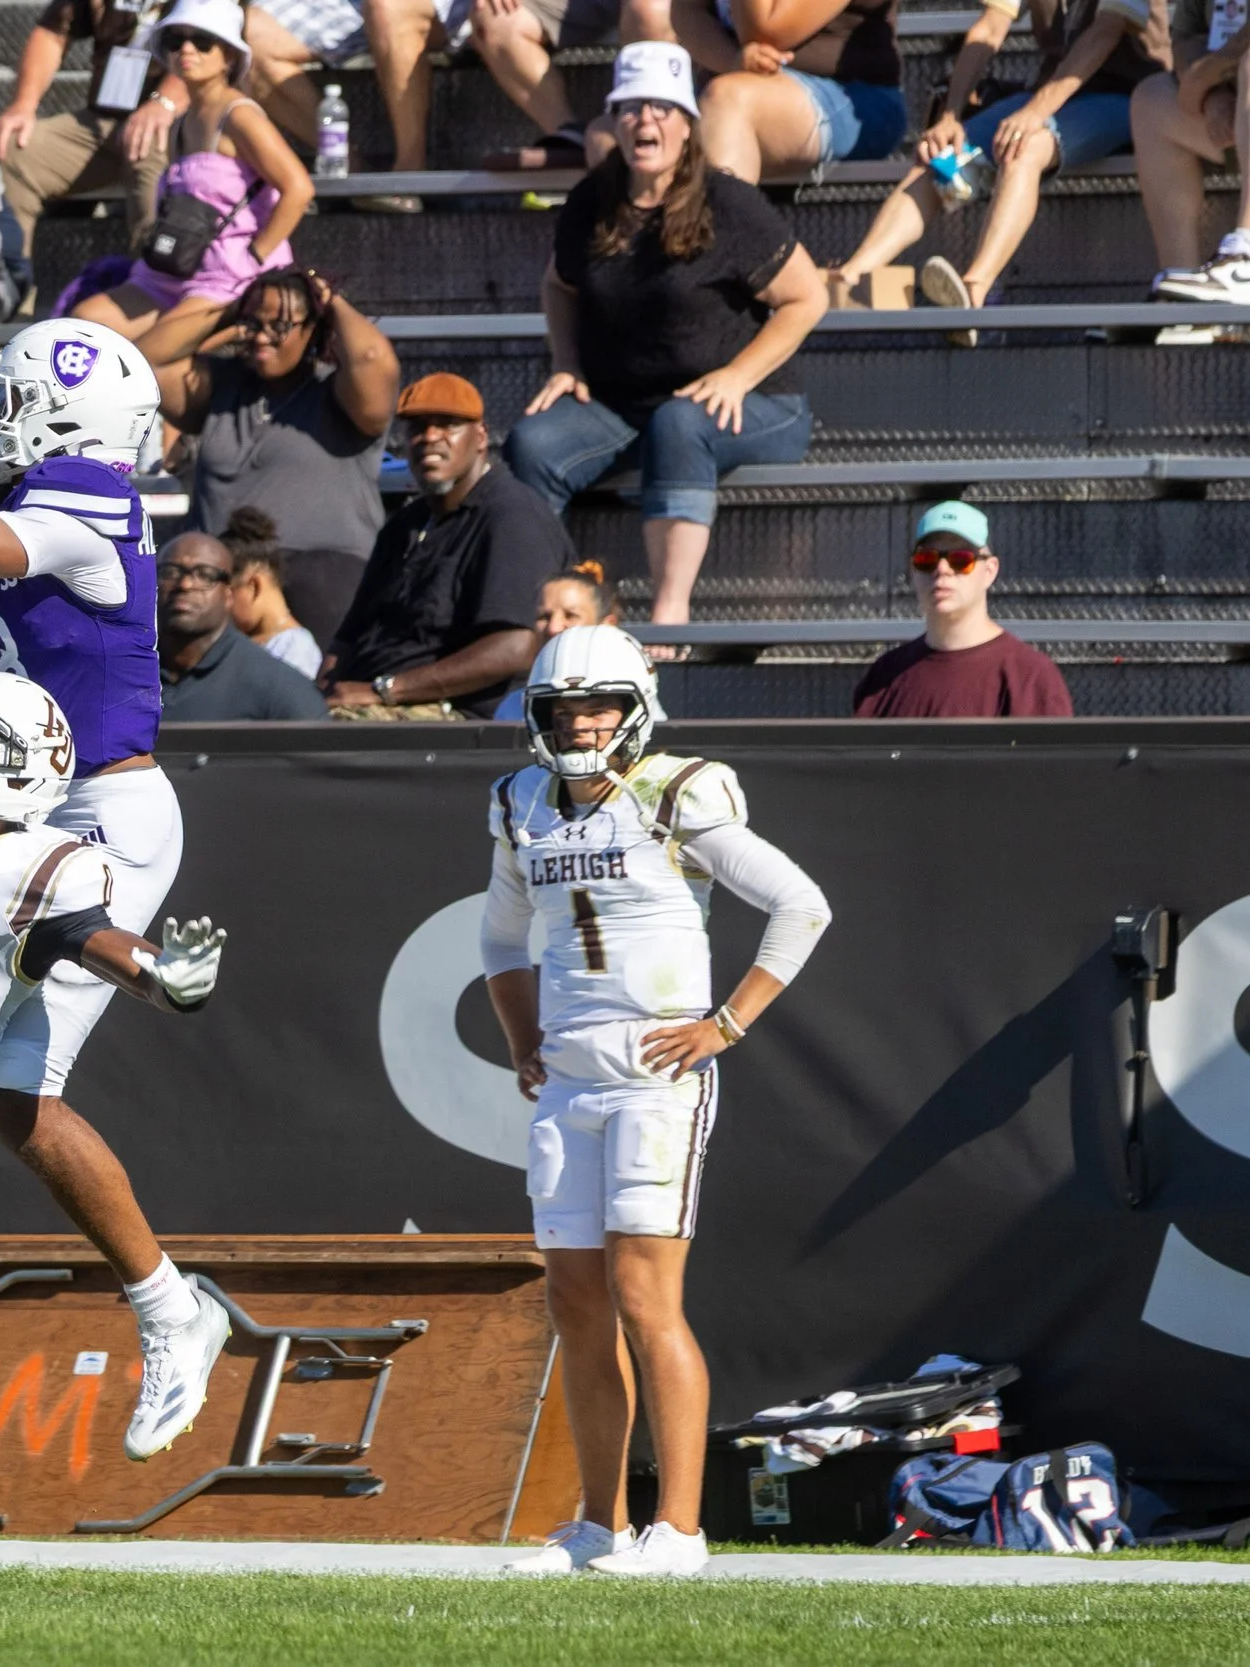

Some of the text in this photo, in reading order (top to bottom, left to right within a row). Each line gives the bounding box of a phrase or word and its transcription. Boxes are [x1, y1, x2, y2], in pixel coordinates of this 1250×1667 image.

[531, 852, 629, 886] LEHIGH
[570, 888, 608, 974] 1
[1033, 1455, 1092, 1486] BDY
